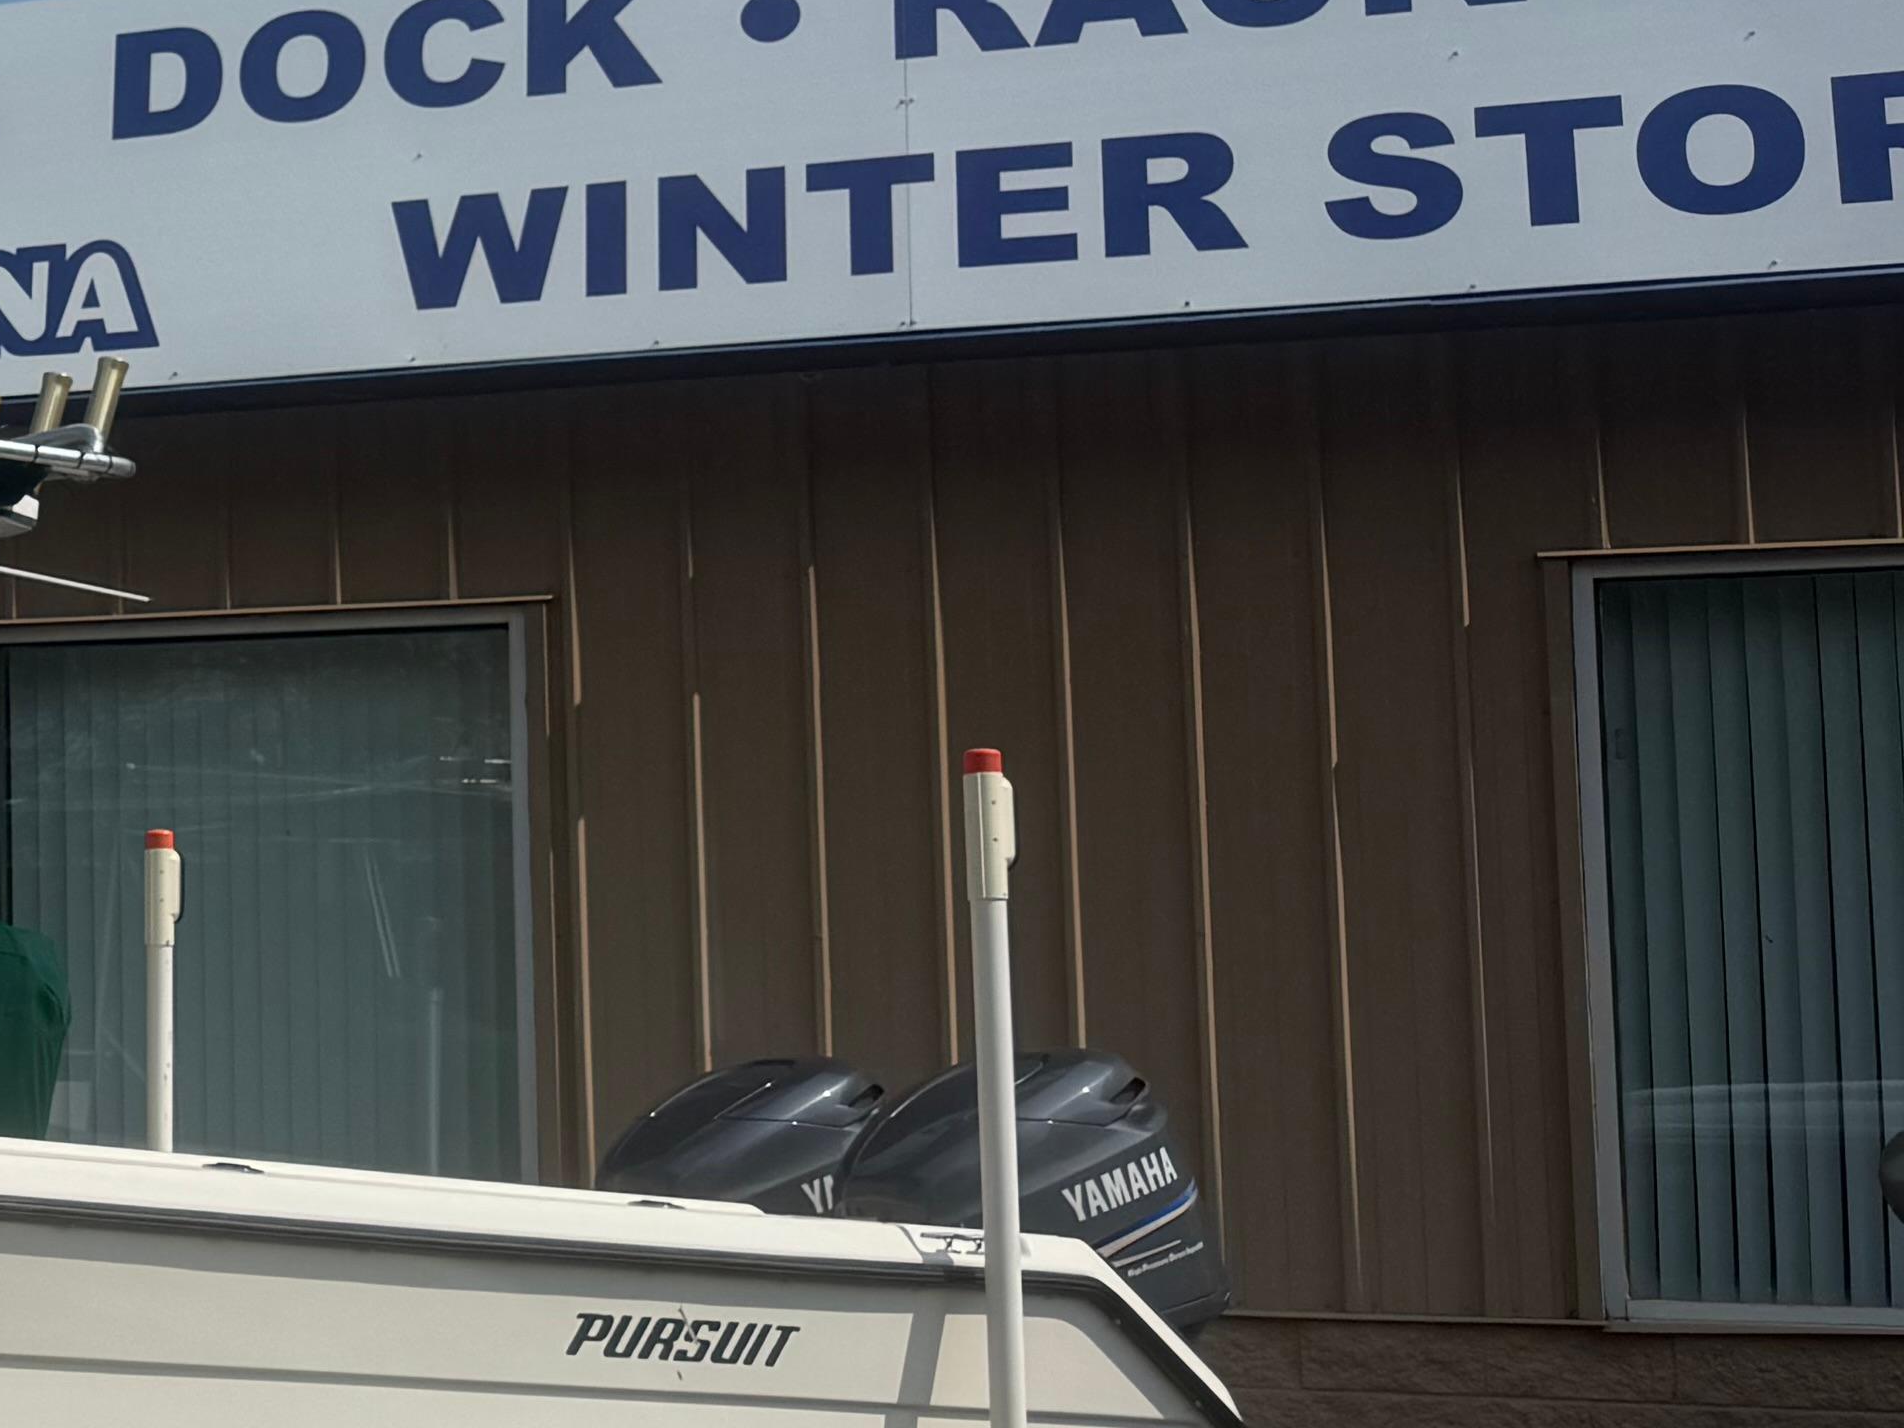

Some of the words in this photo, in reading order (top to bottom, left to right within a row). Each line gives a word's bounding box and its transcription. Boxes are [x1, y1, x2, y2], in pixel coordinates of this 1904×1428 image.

[391, 131, 1248, 310] WINTER
[1061, 1146, 1178, 1222] YAMAHA
[565, 1312, 801, 1367] PURSUIT
